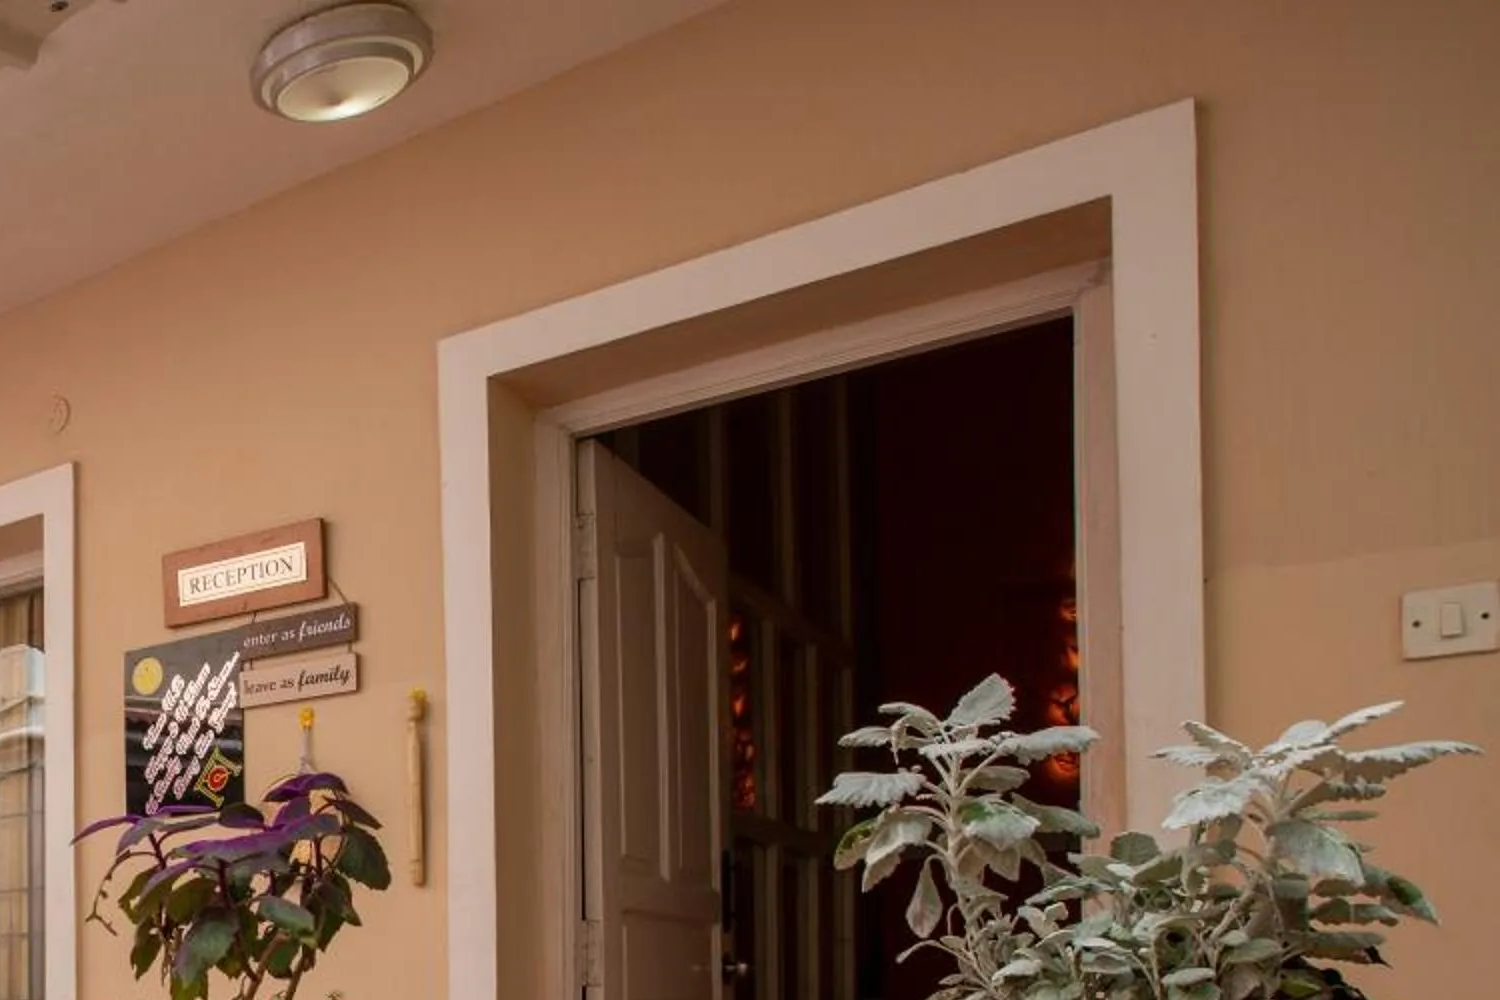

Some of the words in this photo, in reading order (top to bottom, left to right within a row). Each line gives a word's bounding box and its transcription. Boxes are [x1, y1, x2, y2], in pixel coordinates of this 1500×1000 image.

[189, 555, 294, 595] RECEPTION
[243, 632, 277, 648] enter
[281, 629, 295, 641] as
[299, 613, 351, 643] friends
[243, 679, 277, 695] leave
[280, 678, 295, 689] as
[298, 664, 350, 692] family
